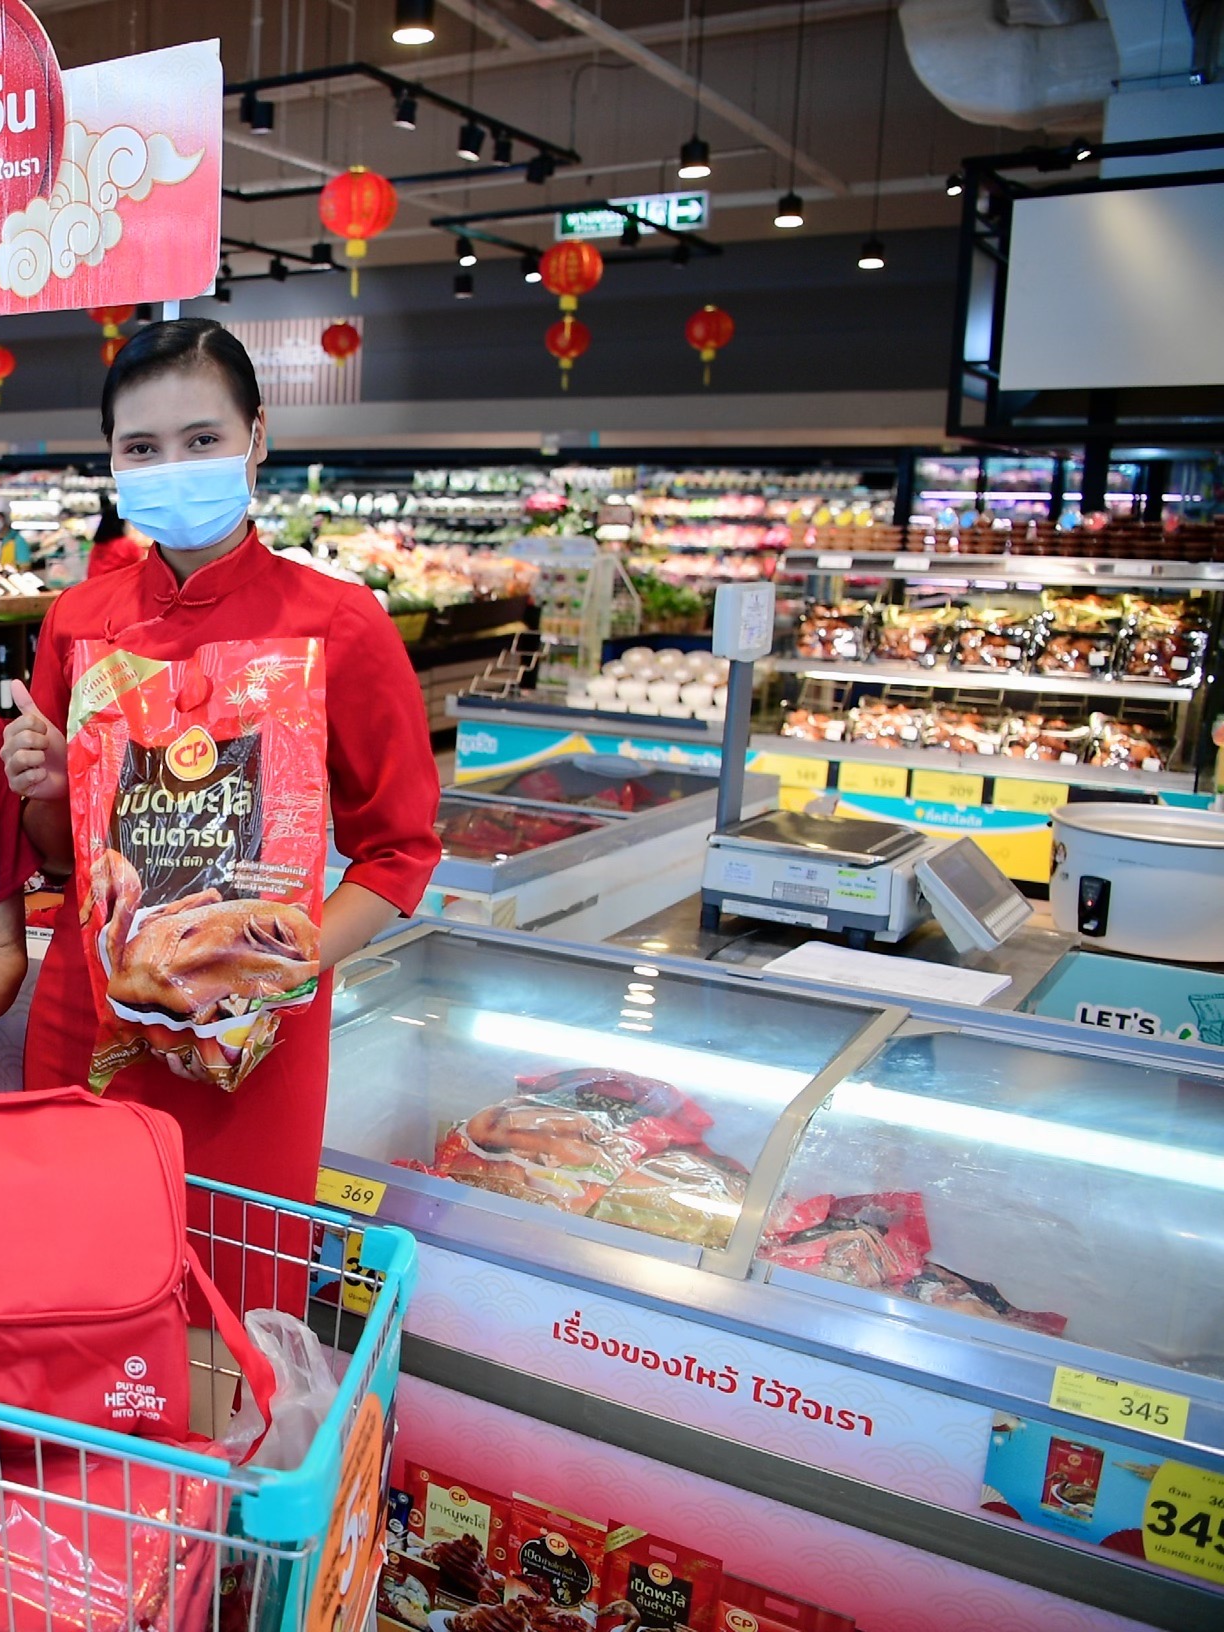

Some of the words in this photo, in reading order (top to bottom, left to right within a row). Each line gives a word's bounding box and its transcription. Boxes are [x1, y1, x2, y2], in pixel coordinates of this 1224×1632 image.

[173, 739, 209, 768] CP
[117, 776, 253, 816] เป็ดพะโล้
[131, 818, 234, 848] ต้นตำรับ
[1080, 1007, 1156, 1035] LET'S
[341, 1184, 374, 1204] 369
[127, 1362, 144, 1374] CP
[553, 1310, 739, 1394] เรื่องของไหว้
[752, 1376, 873, 1437] ไว้ใจเรา
[116, 1381, 134, 1391] PUT
[136, 1384, 155, 1395] OUR
[112, 1408, 134, 1418] INTO
[136, 1409, 160, 1421] FOOD
[1119, 1397, 1169, 1425] 345
[451, 1491, 465, 1502] CP
[430, 1500, 486, 1531] ขาหมูพะโล้
[549, 1538, 565, 1550] CP
[1155, 1544, 1191, 1561] ประหยัด
[651, 1568, 669, 1580] CP
[630, 1577, 686, 1608] เป็ดพะโล้
[636, 1595, 677, 1617] ต้นตำรับ
[730, 1614, 754, 1629] CP
